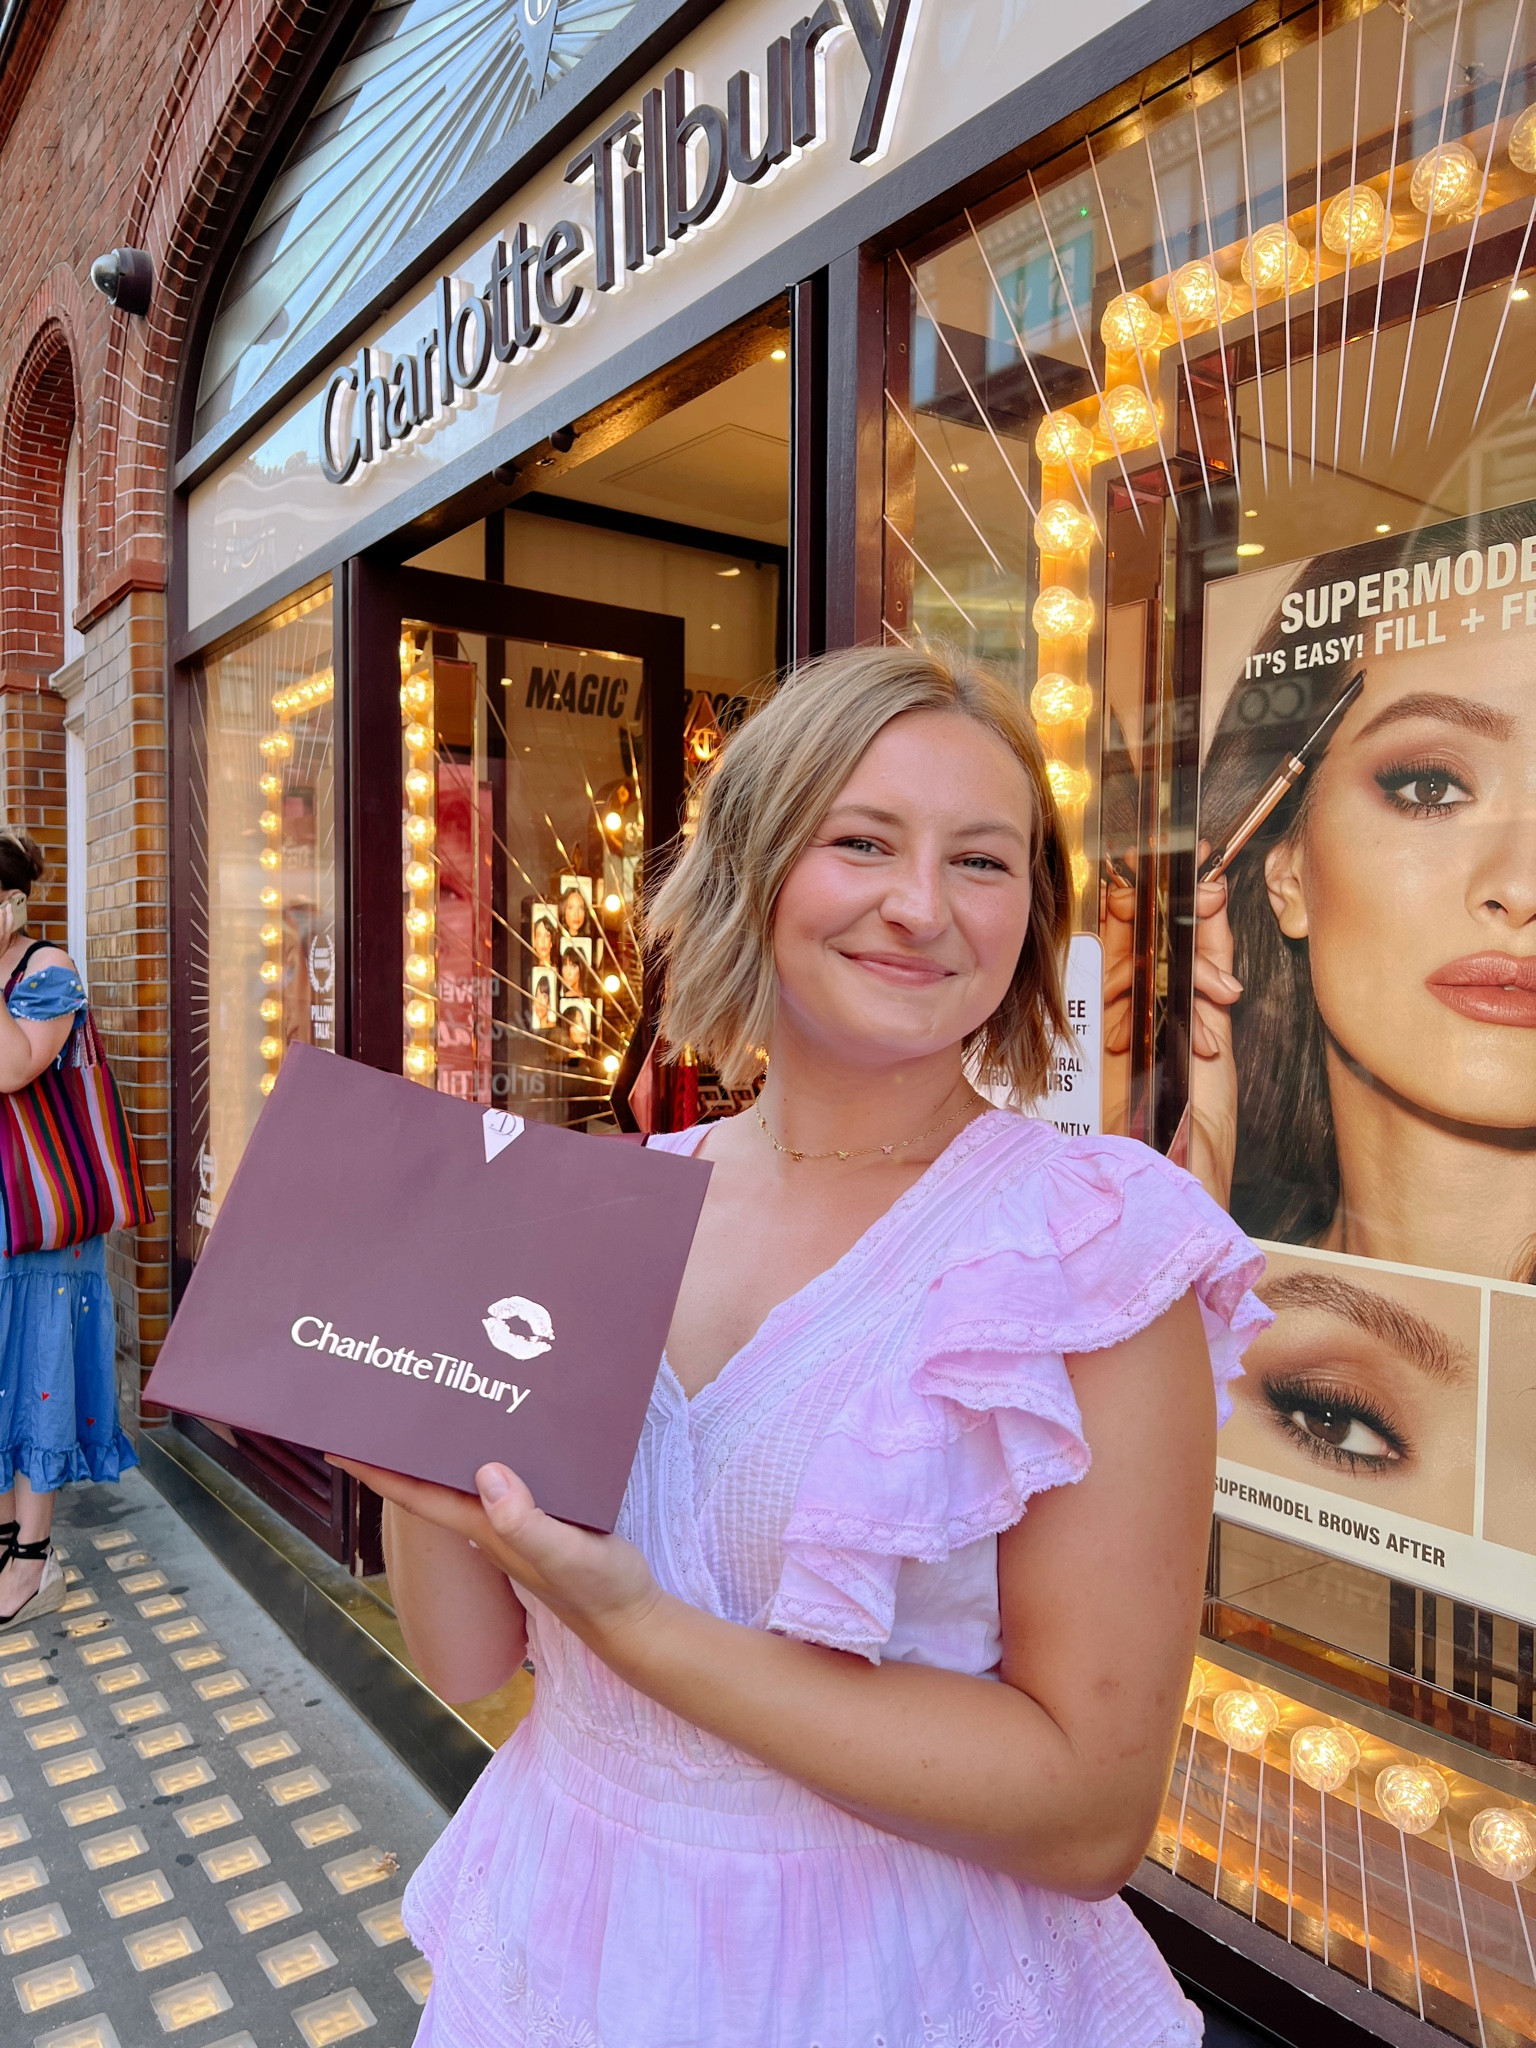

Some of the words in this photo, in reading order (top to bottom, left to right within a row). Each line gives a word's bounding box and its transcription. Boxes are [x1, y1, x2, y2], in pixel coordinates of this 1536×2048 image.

[1280, 535, 1536, 634] SUPERMODE
[1244, 649, 1287, 680] IT'S
[1294, 633, 1364, 671] EASY!
[1375, 610, 1446, 655] FILL
[525, 666, 629, 719] MAGIC
[1067, 1000, 1086, 1018] EE
[1318, 1510, 1380, 1546] BROWS
[1386, 1533, 1446, 1567] AFTER
